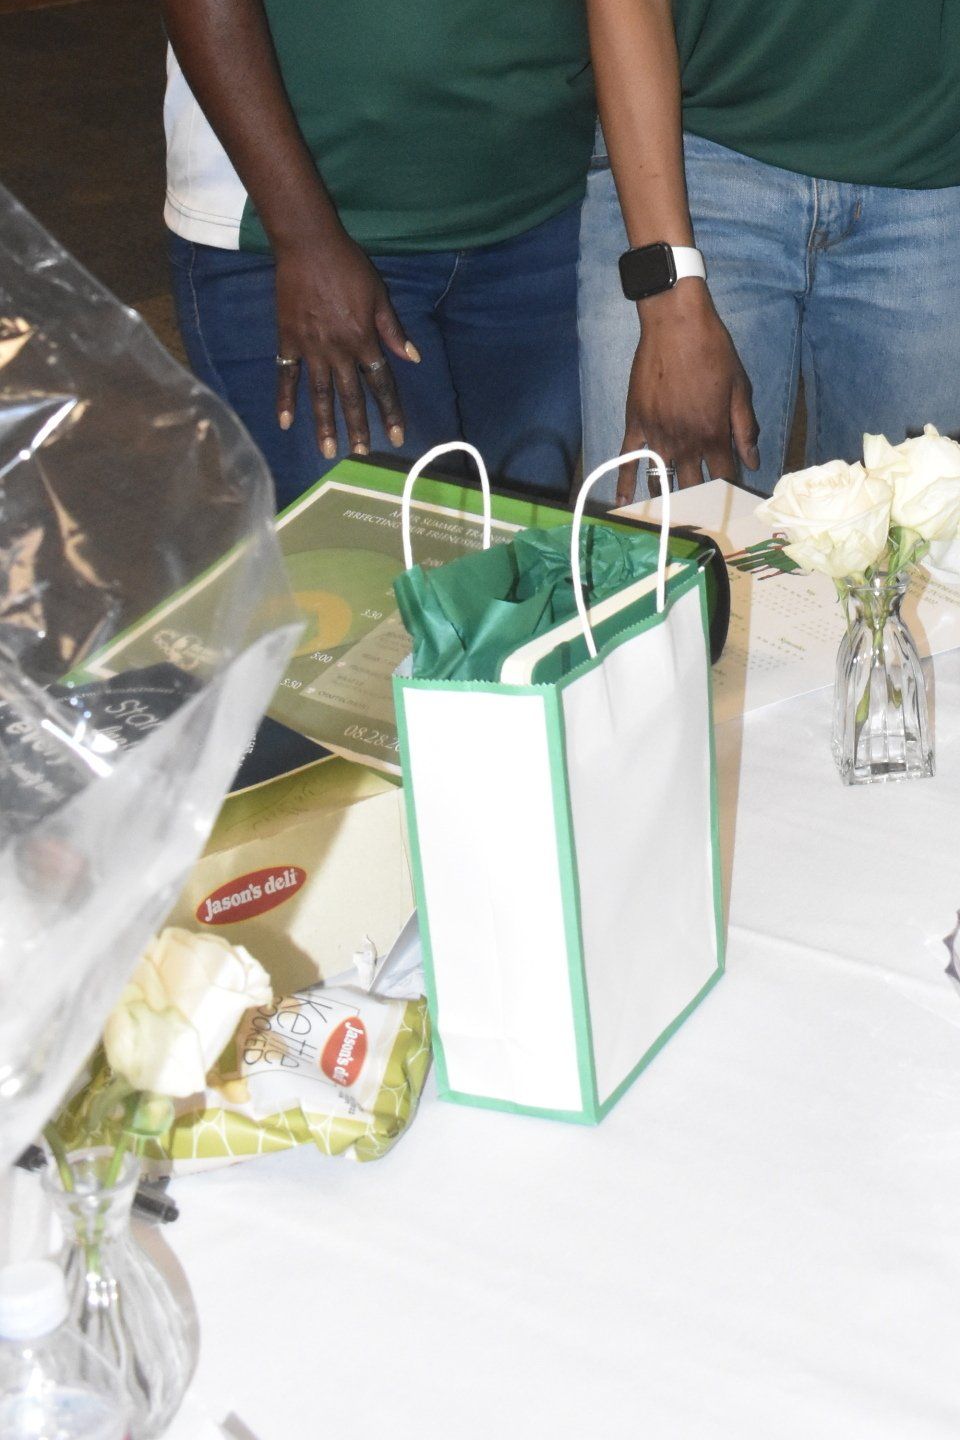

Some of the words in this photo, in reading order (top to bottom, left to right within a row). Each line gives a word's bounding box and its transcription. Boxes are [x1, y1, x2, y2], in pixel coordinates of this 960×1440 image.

[310, 651, 333, 664] 5:00
[205, 883, 262, 922] Jason's
[264, 868, 298, 895] deli
[243, 996, 284, 1066] OOKED
